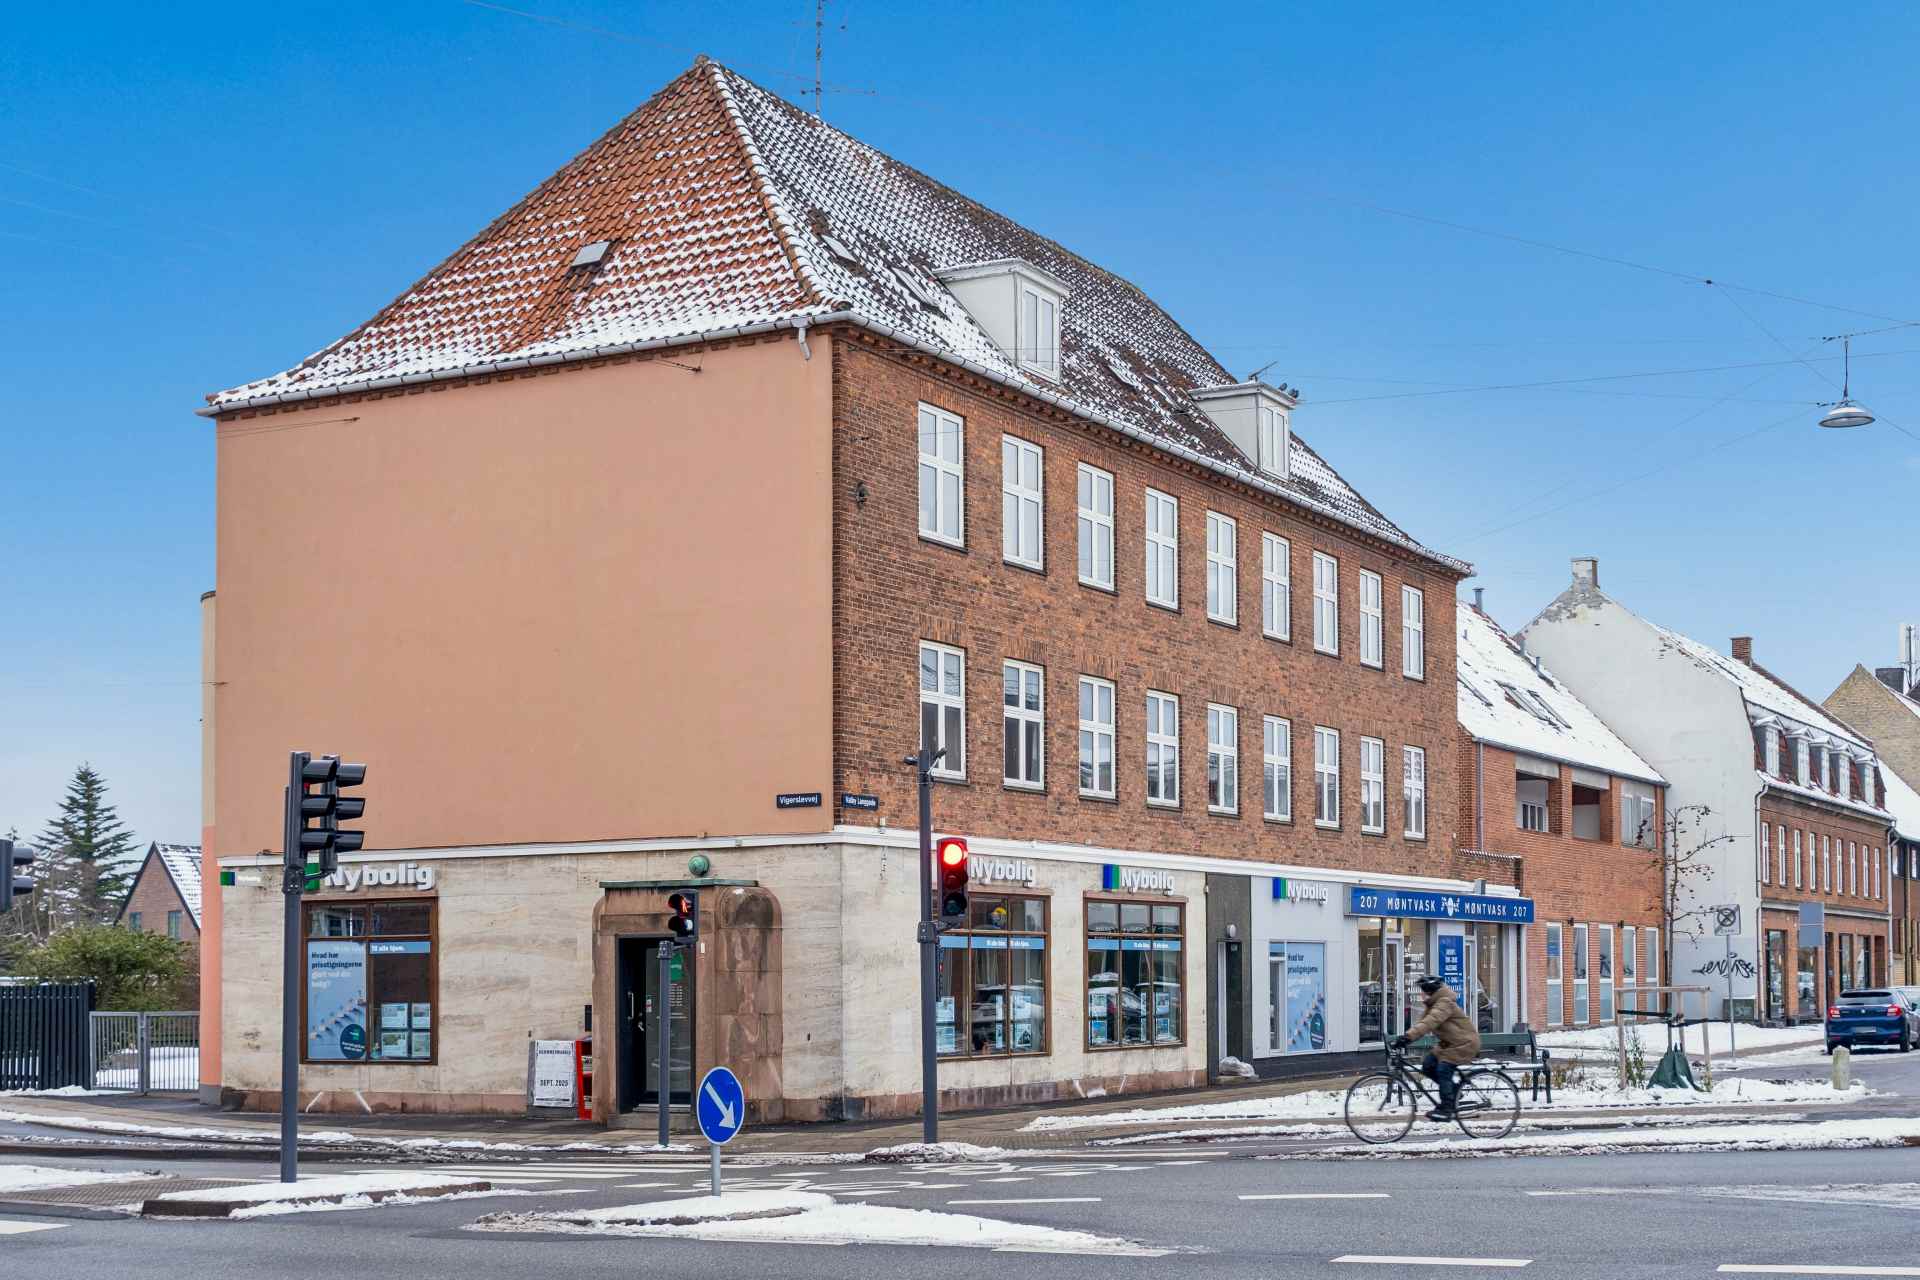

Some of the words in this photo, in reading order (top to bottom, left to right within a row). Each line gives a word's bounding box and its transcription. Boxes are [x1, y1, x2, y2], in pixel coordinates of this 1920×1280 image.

[779, 794, 818, 805] Vigerslevvej
[324, 862, 435, 891] Nybolig
[970, 856, 1036, 888] Nybolig
[1120, 868, 1175, 894] Nybolig
[1287, 879, 1328, 904] Nybolig
[1360, 895, 1378, 909] 207
[1387, 896, 1436, 912] MØNTVASK
[1464, 902, 1507, 916] MØNTVASK
[1513, 905, 1527, 917] 207
